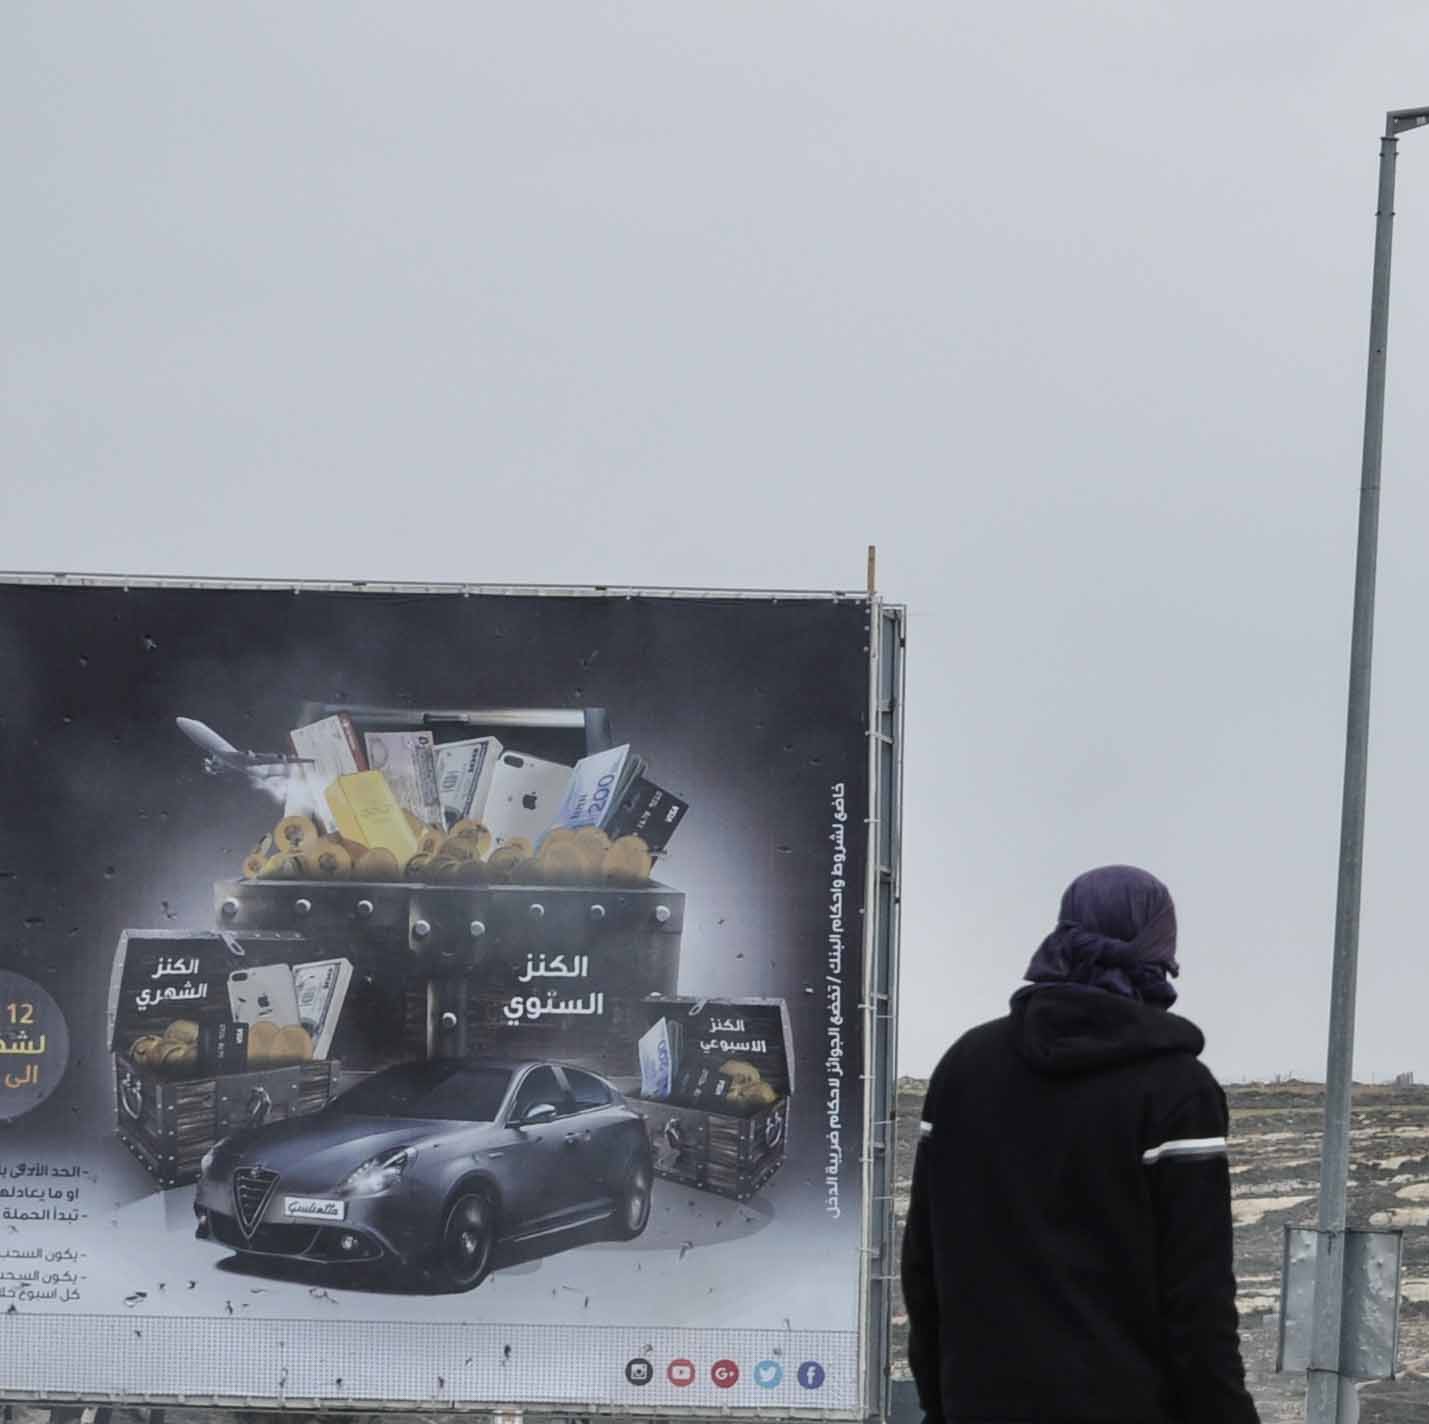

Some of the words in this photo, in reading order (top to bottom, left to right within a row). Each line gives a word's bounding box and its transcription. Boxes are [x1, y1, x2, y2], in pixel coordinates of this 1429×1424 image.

[831, 783, 847, 822] خاضع
[829, 824, 846, 876] لشروط
[152, 957, 199, 978] الكنز
[518, 953, 588, 982] الكنز
[828, 935, 845, 974] البنك
[136, 981, 208, 1011] الشهري
[503, 992, 604, 1025] السنوي
[7, 1002, 33, 1024] 12
[709, 1017, 745, 1033] الكنز
[700, 1038, 767, 1055] الاسبوعي
[5, 1064, 38, 1089] الى
[824, 1130, 842, 1174] ضريبة
[825, 1177, 840, 1218] الدخل
